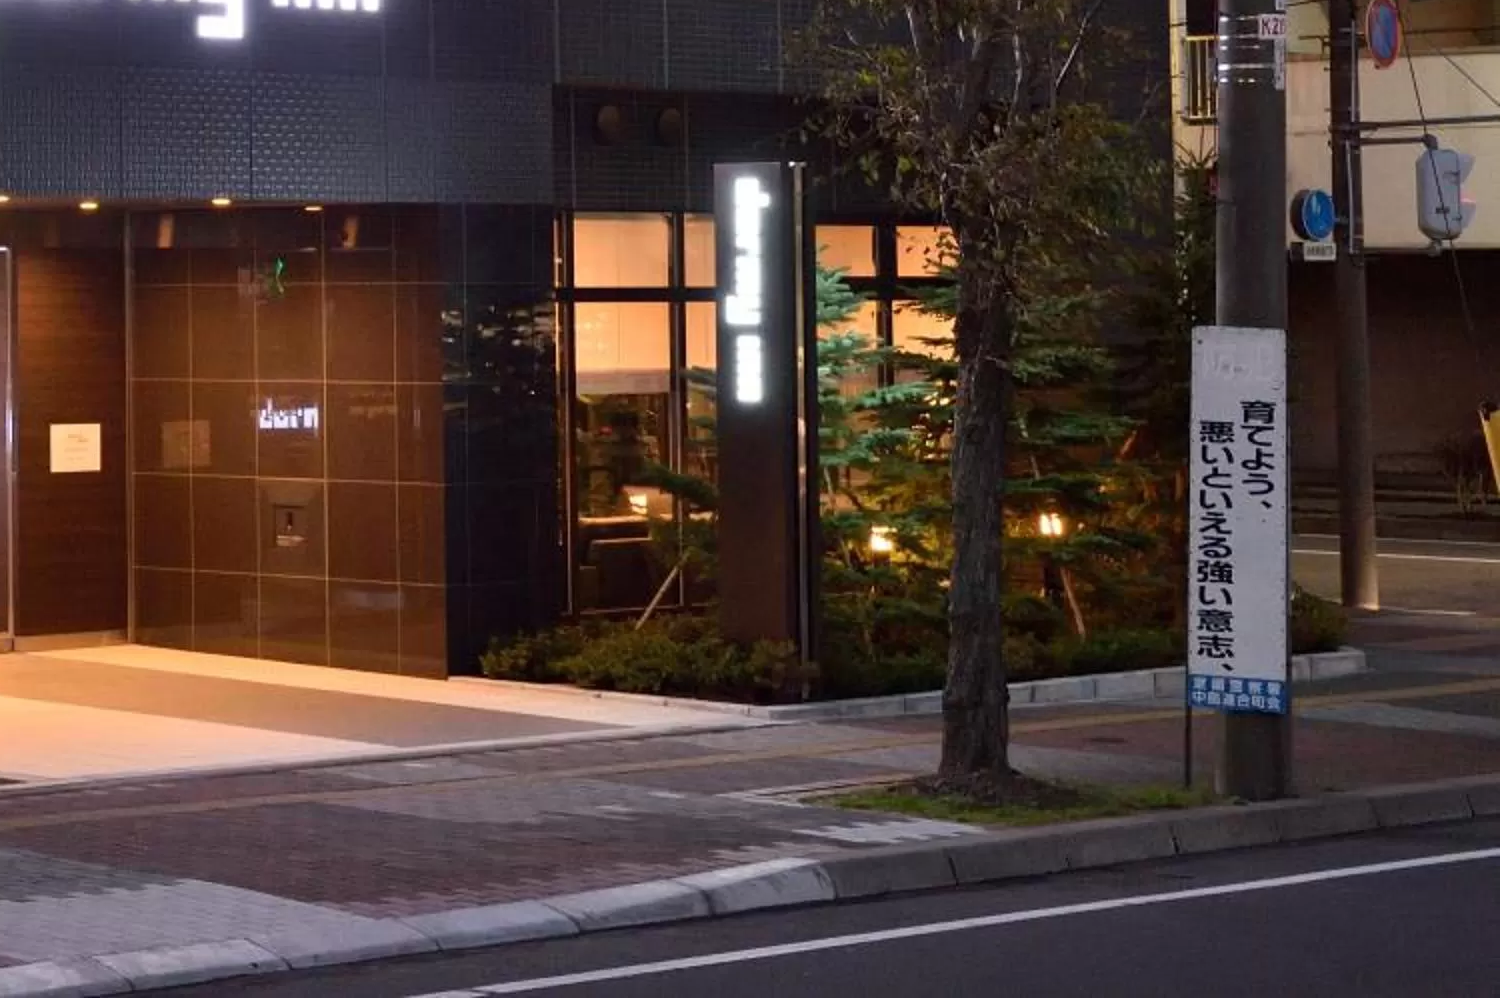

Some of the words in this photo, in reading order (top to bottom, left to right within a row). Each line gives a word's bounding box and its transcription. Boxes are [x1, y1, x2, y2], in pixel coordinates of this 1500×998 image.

[1240, 400, 1277, 509] 育てよう、
[1196, 420, 1235, 671] 悪いといえる強い意志、
